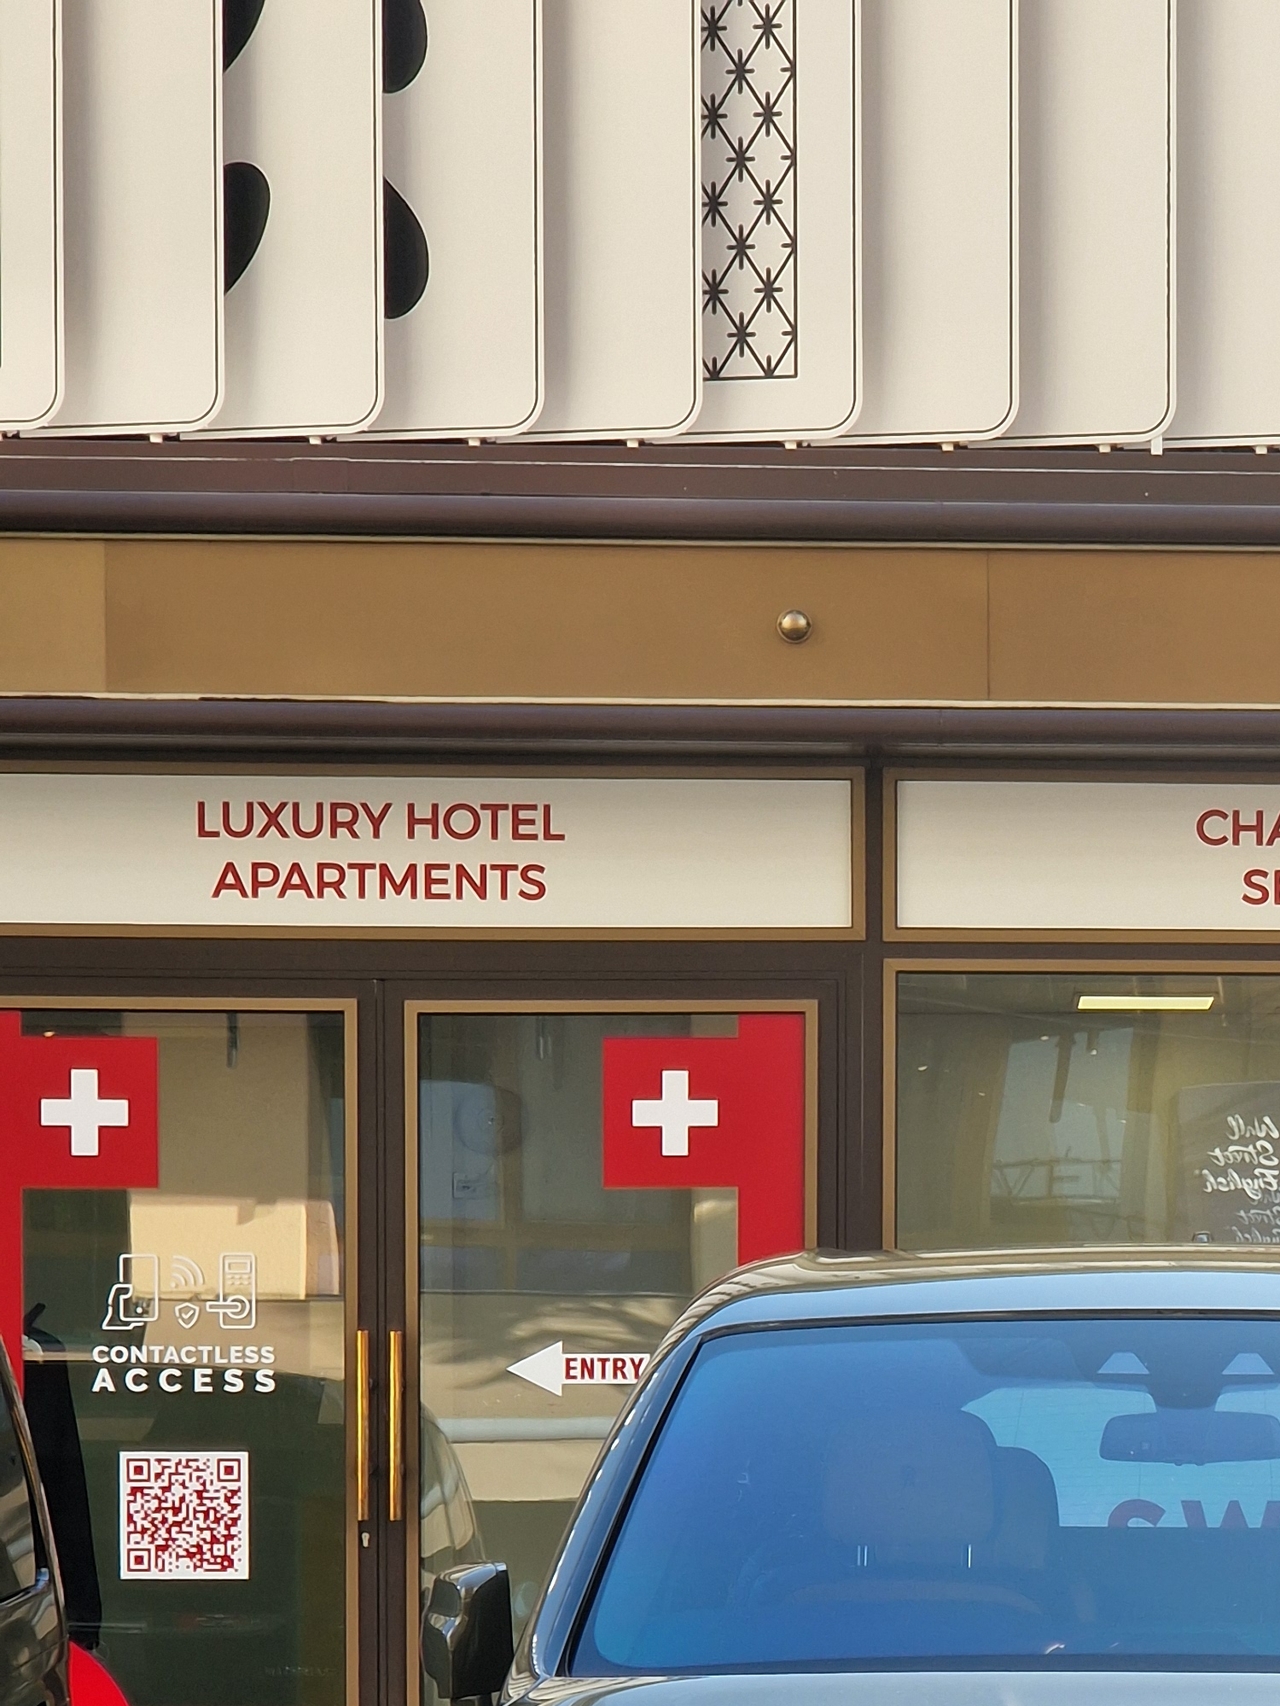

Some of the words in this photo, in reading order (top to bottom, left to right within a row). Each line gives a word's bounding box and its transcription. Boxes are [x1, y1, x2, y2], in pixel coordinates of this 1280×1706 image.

[196, 801, 391, 840] LUXURY
[407, 802, 565, 842] HOTEL
[213, 862, 546, 901] APARTMENTS
[92, 1345, 276, 1365] CONTACTLESS
[91, 1367, 277, 1393] ACCESS
[565, 1357, 645, 1380] ENTRY
